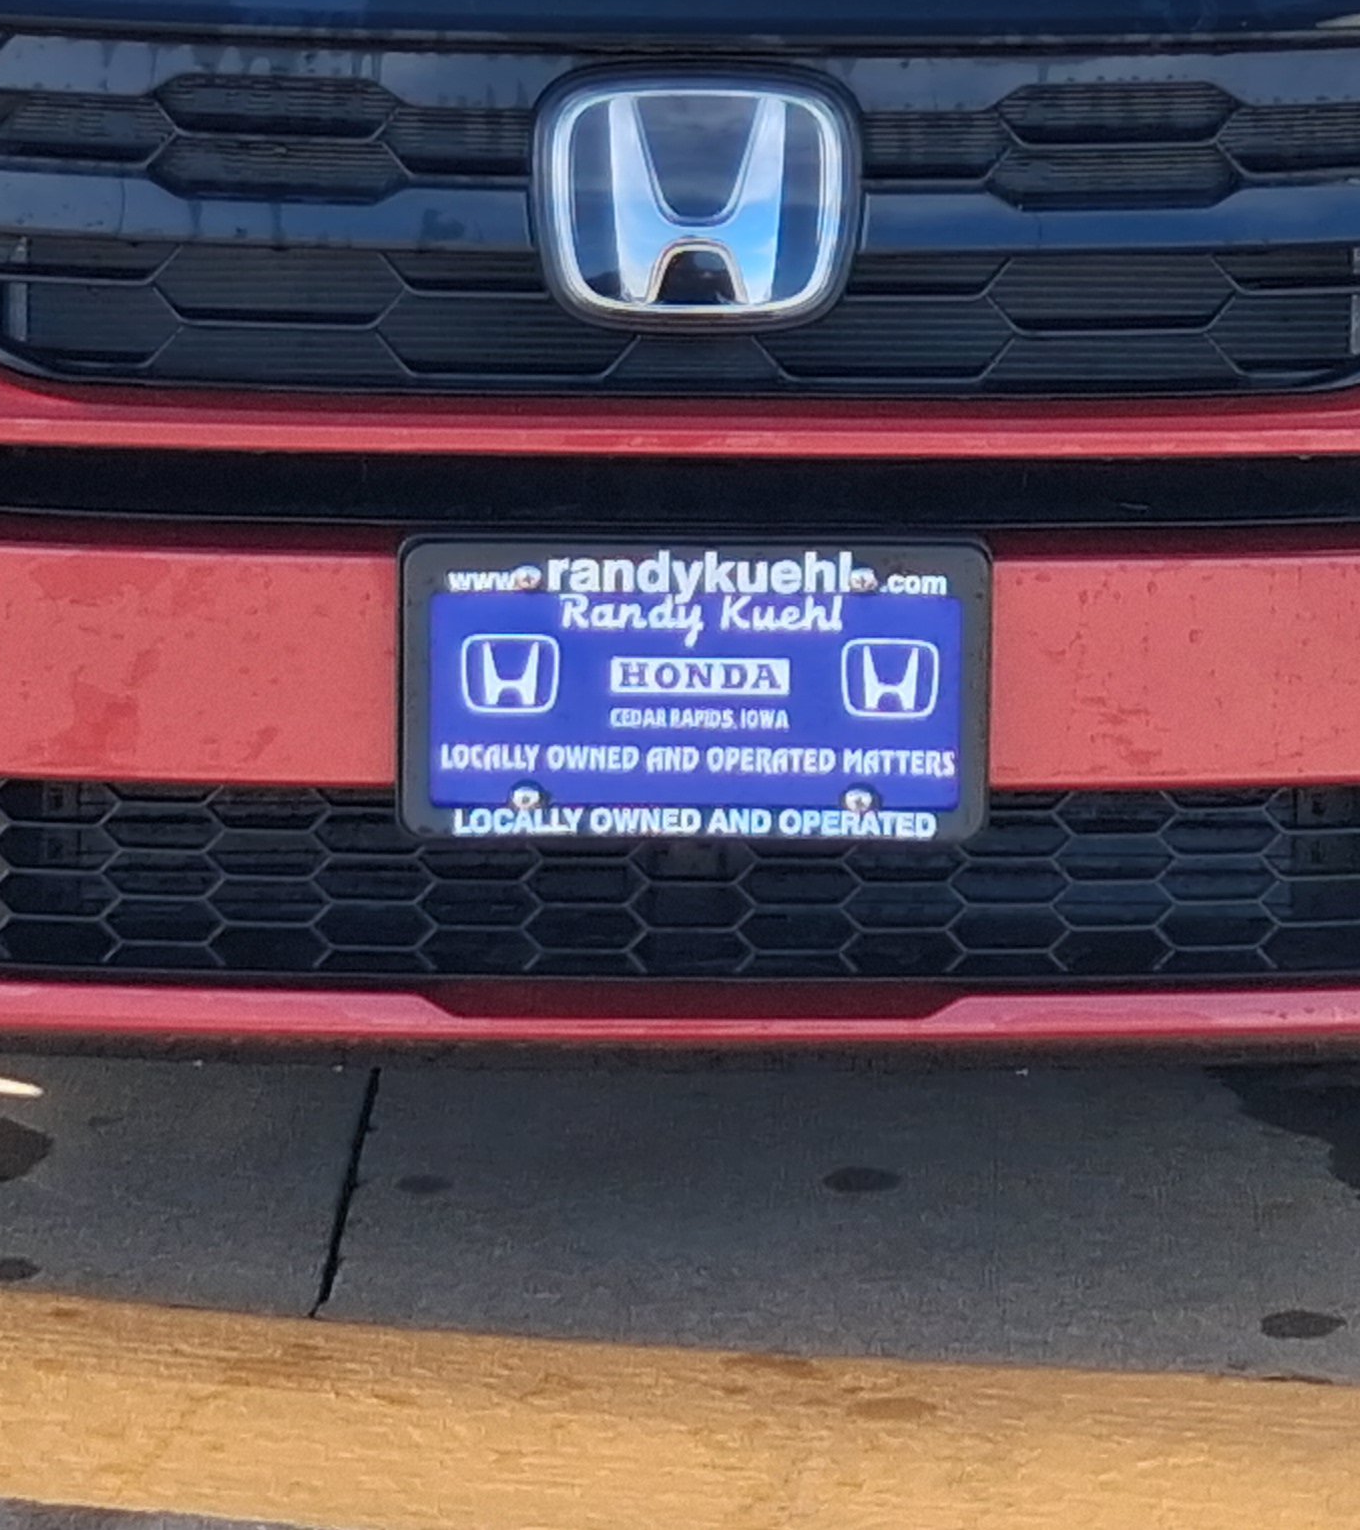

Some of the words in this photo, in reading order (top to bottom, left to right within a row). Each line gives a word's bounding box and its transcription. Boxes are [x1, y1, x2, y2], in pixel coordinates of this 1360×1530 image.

[559, 594, 704, 647] Randy
[720, 595, 843, 631] Kuehl
[618, 662, 782, 689] HONDA
[611, 708, 667, 728] CEDAR
[740, 709, 790, 730] IOWA
[440, 744, 540, 771] LOCALLY
[546, 744, 640, 770] OWNED
[646, 746, 700, 773] AND
[706, 746, 836, 774] OPERATED
[842, 748, 956, 777] MATTERS
[453, 807, 584, 835] LOCALLY
[590, 807, 702, 835] OWNED
[706, 809, 772, 835] AND
[778, 809, 938, 839] OPERATED
